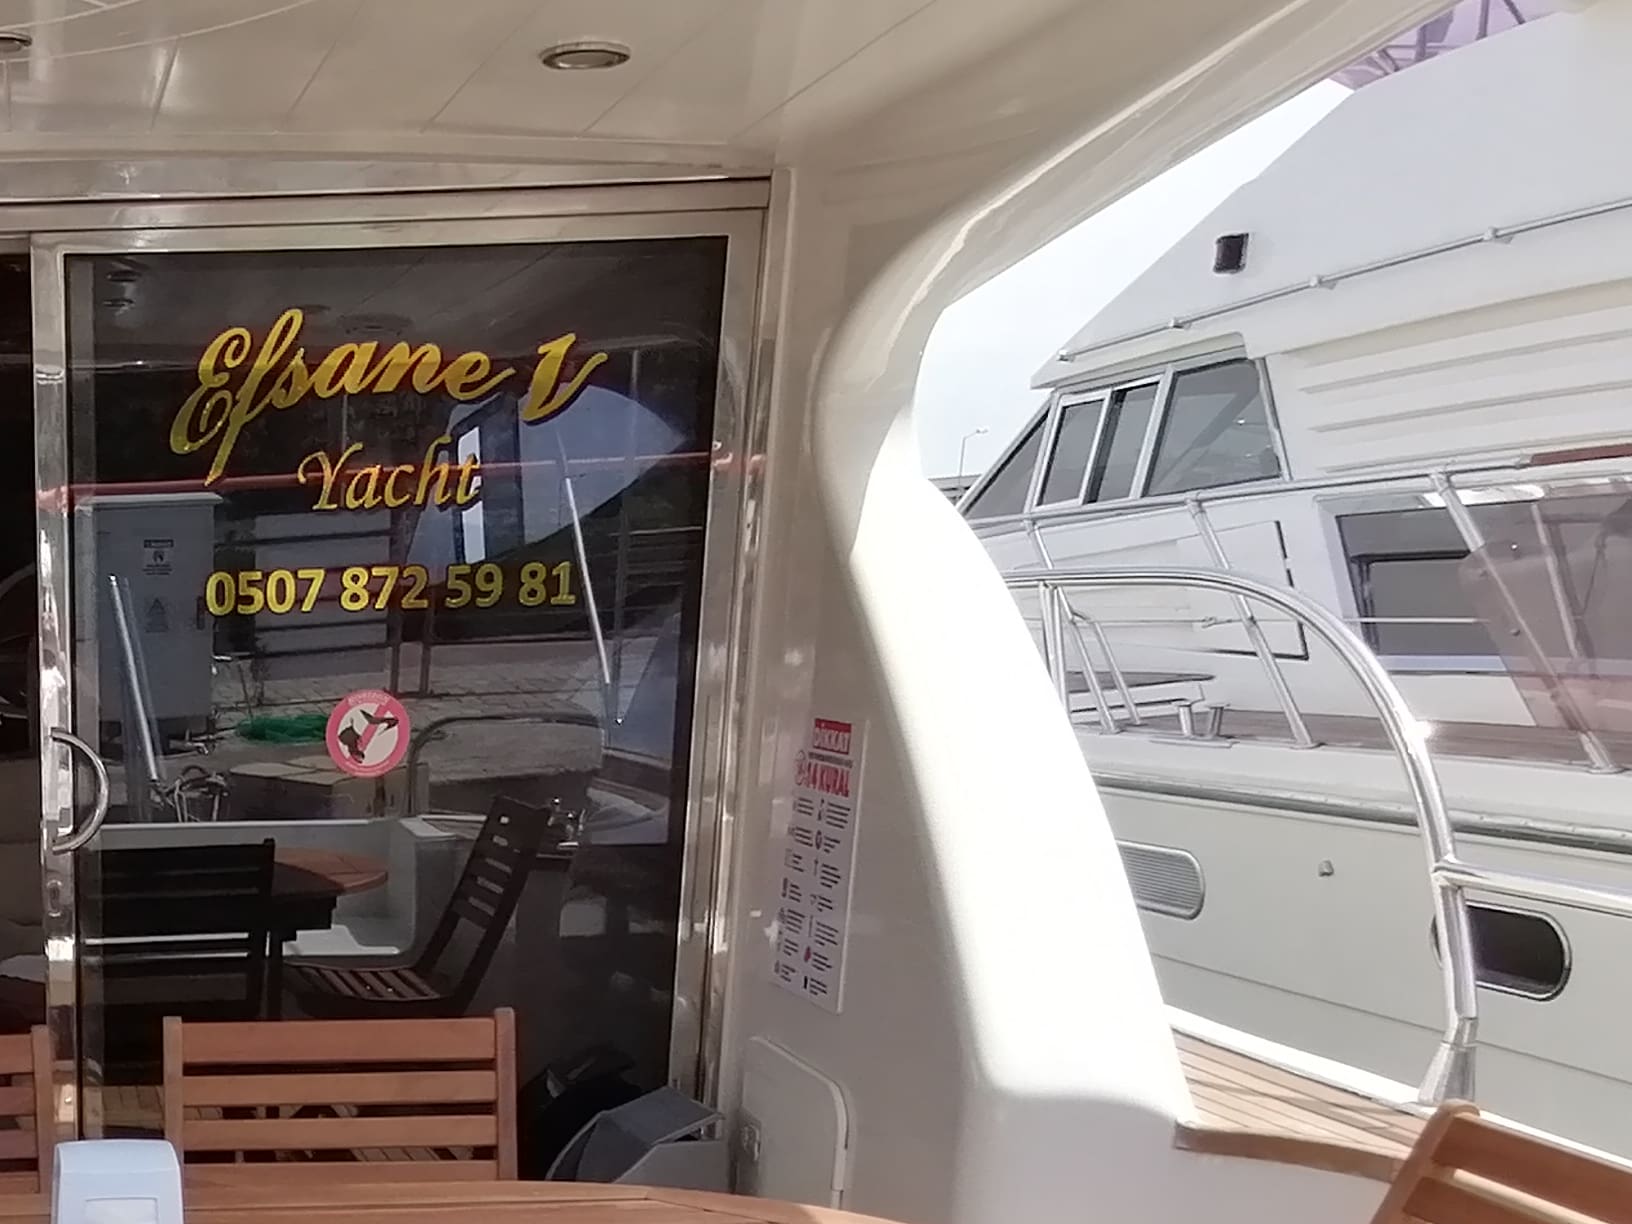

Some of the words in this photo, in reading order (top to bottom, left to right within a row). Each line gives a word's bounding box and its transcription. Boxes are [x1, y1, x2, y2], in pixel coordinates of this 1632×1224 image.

[170, 308, 516, 487] Efsane
[297, 435, 481, 511] Yacht
[205, 568, 326, 617] 0507
[340, 565, 429, 612] 872
[445, 562, 504, 608] 59
[519, 559, 576, 607] 81
